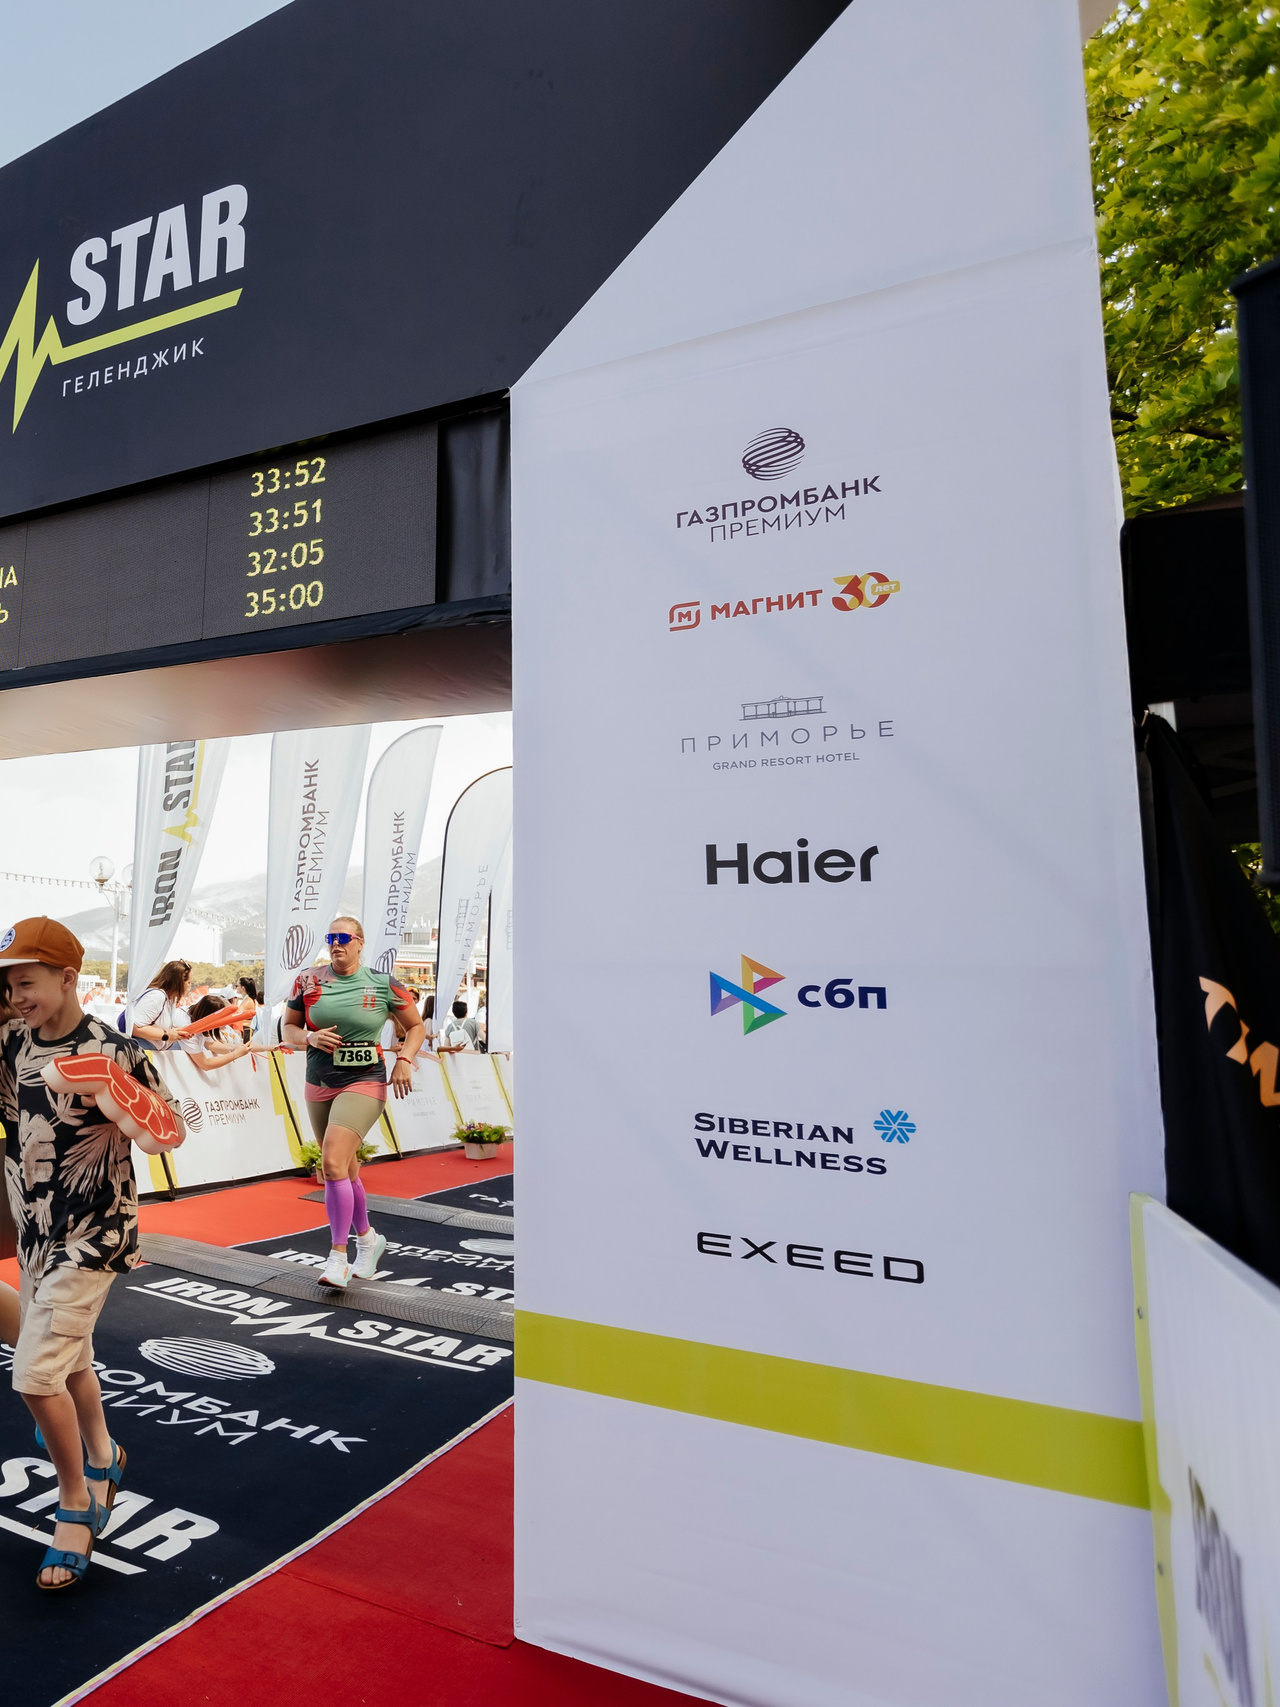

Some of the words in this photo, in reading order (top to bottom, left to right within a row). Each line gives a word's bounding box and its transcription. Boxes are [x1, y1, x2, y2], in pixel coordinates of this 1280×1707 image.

[67, 183, 249, 326] STAR
[62, 336, 206, 397] ГЕЛЕНДЖИК
[251, 457, 326, 497] 33:52
[248, 499, 322, 536] 33:51
[676, 475, 882, 529] ГАЗПРОМБАНК
[710, 503, 847, 543] ПРЕМИУМ
[247, 538, 324, 577] 32:05
[245, 580, 324, 617] 35:00
[710, 589, 823, 621] МАГНИТ
[831, 571, 892, 612] 30
[681, 720, 895, 754] ПРИМОРЬЕ
[712, 759, 757, 771] GRAND
[761, 755, 812, 767] RESORT
[816, 752, 860, 764] HOTEL
[304, 811, 330, 911] ПРЕМИУМ
[385, 811, 405, 936] ГАЗПРОМБАНК
[706, 838, 879, 885] Haier
[797, 978, 888, 1010] сбп
[338, 1050, 372, 1062] 7368
[205, 1099, 260, 1112] ГАЗПРОМБАНК
[693, 1111, 855, 1145] SIBERIAN
[694, 1138, 888, 1176] WELLNESS
[697, 1231, 925, 1285] EXEED
[144, 1277, 292, 1316] IRON
[338, 1320, 513, 1367] STAR
